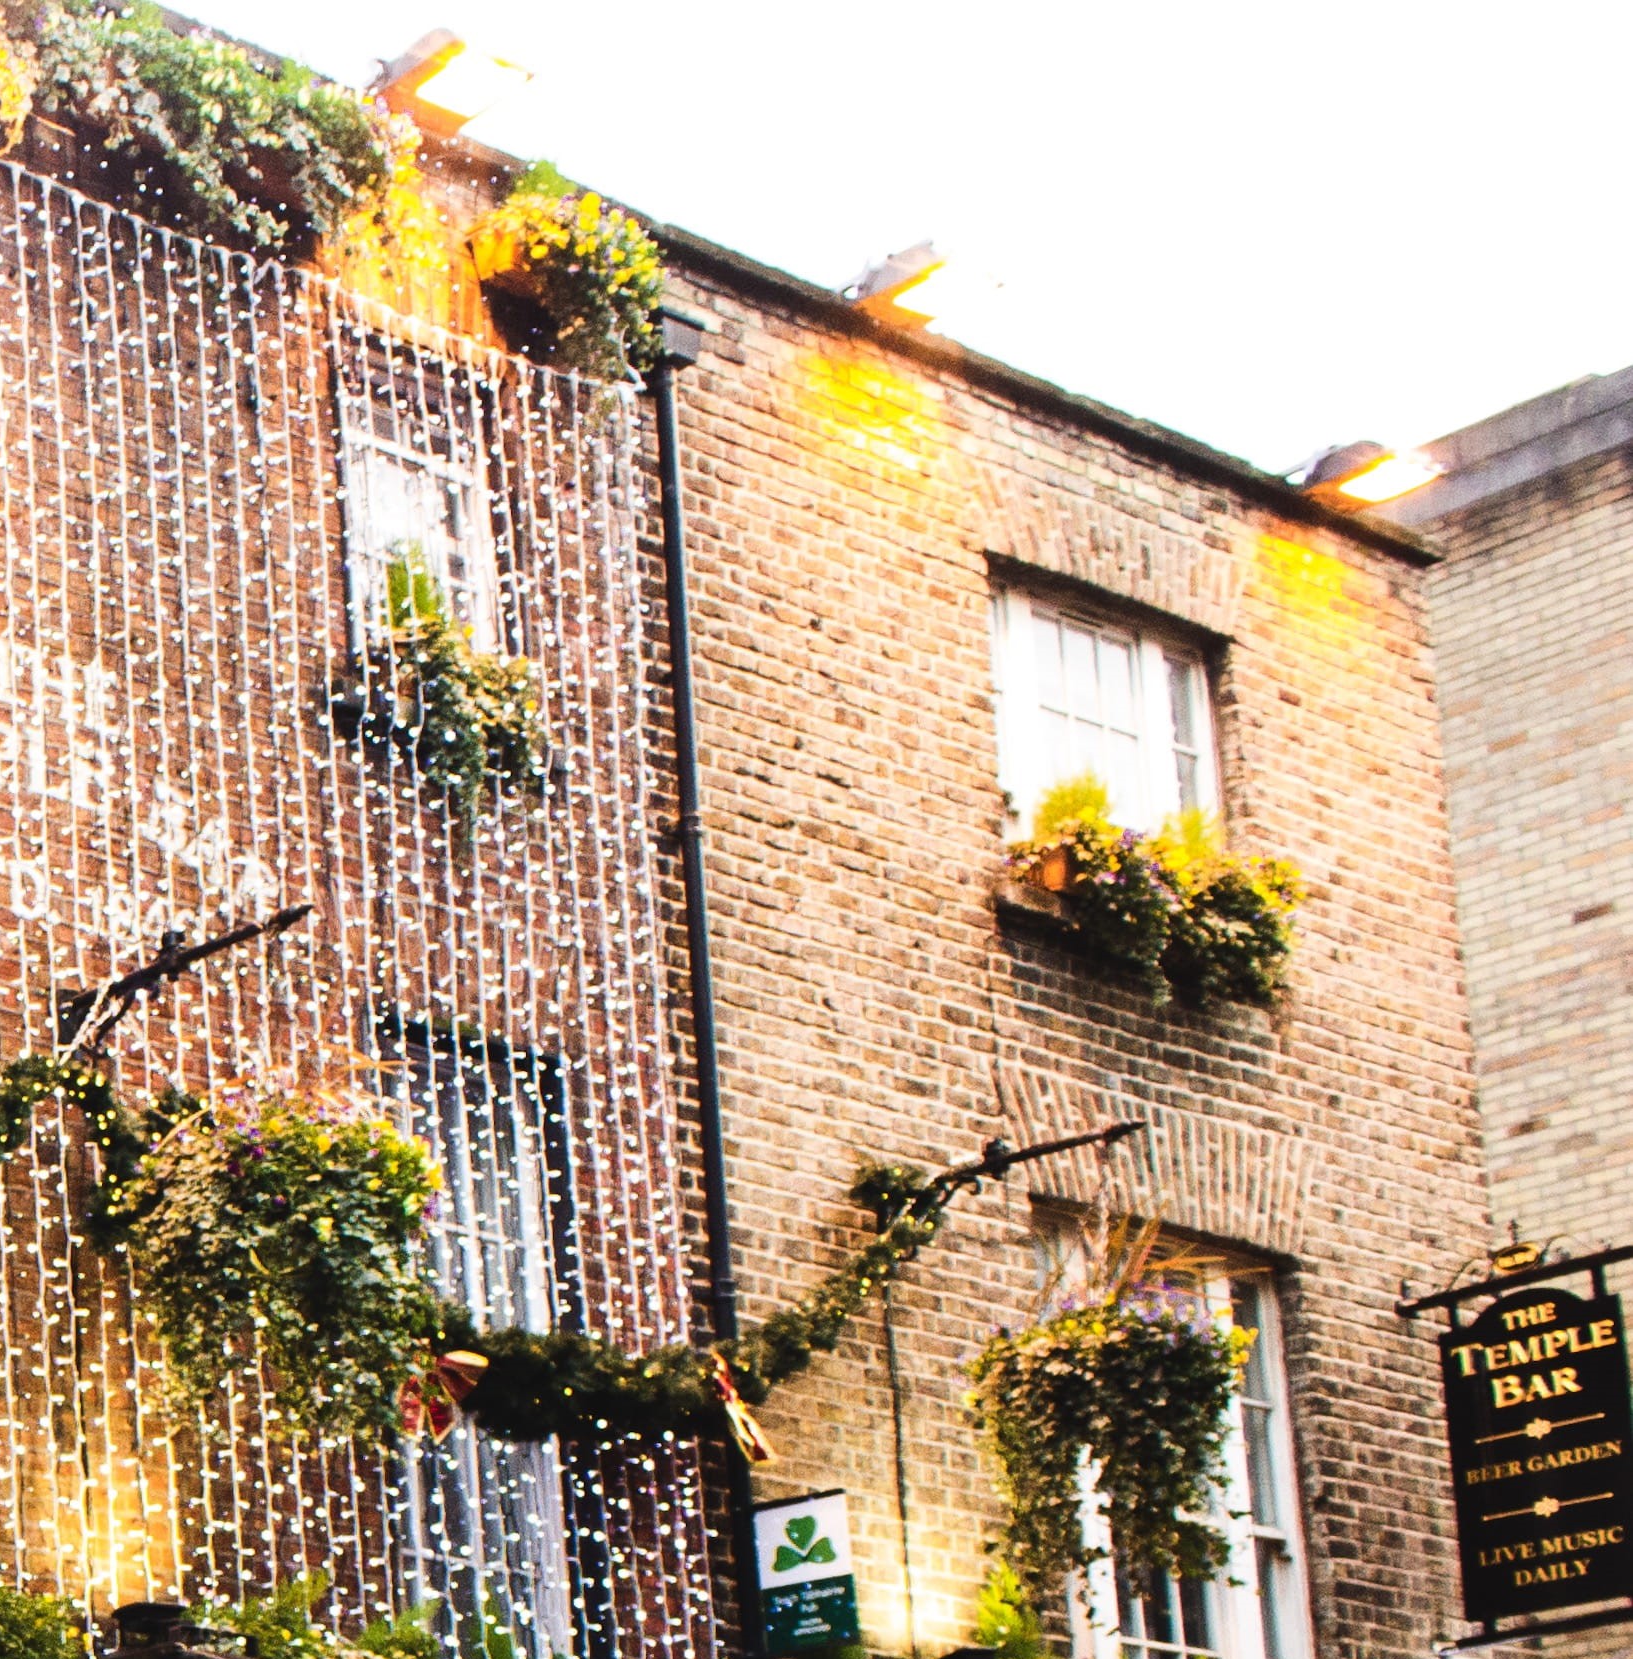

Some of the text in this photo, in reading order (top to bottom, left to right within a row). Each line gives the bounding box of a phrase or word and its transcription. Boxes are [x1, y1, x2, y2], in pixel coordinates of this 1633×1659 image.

[1501, 1302, 1557, 1331] THE
[1450, 1320, 1618, 1377] TEMPLE
[1492, 1367, 1582, 1409] BAR
[1466, 1440, 1623, 1486] BEER GARDEN
[1479, 1525, 1625, 1568] LIVE MUSIC
[1513, 1559, 1592, 1587] DAILY
